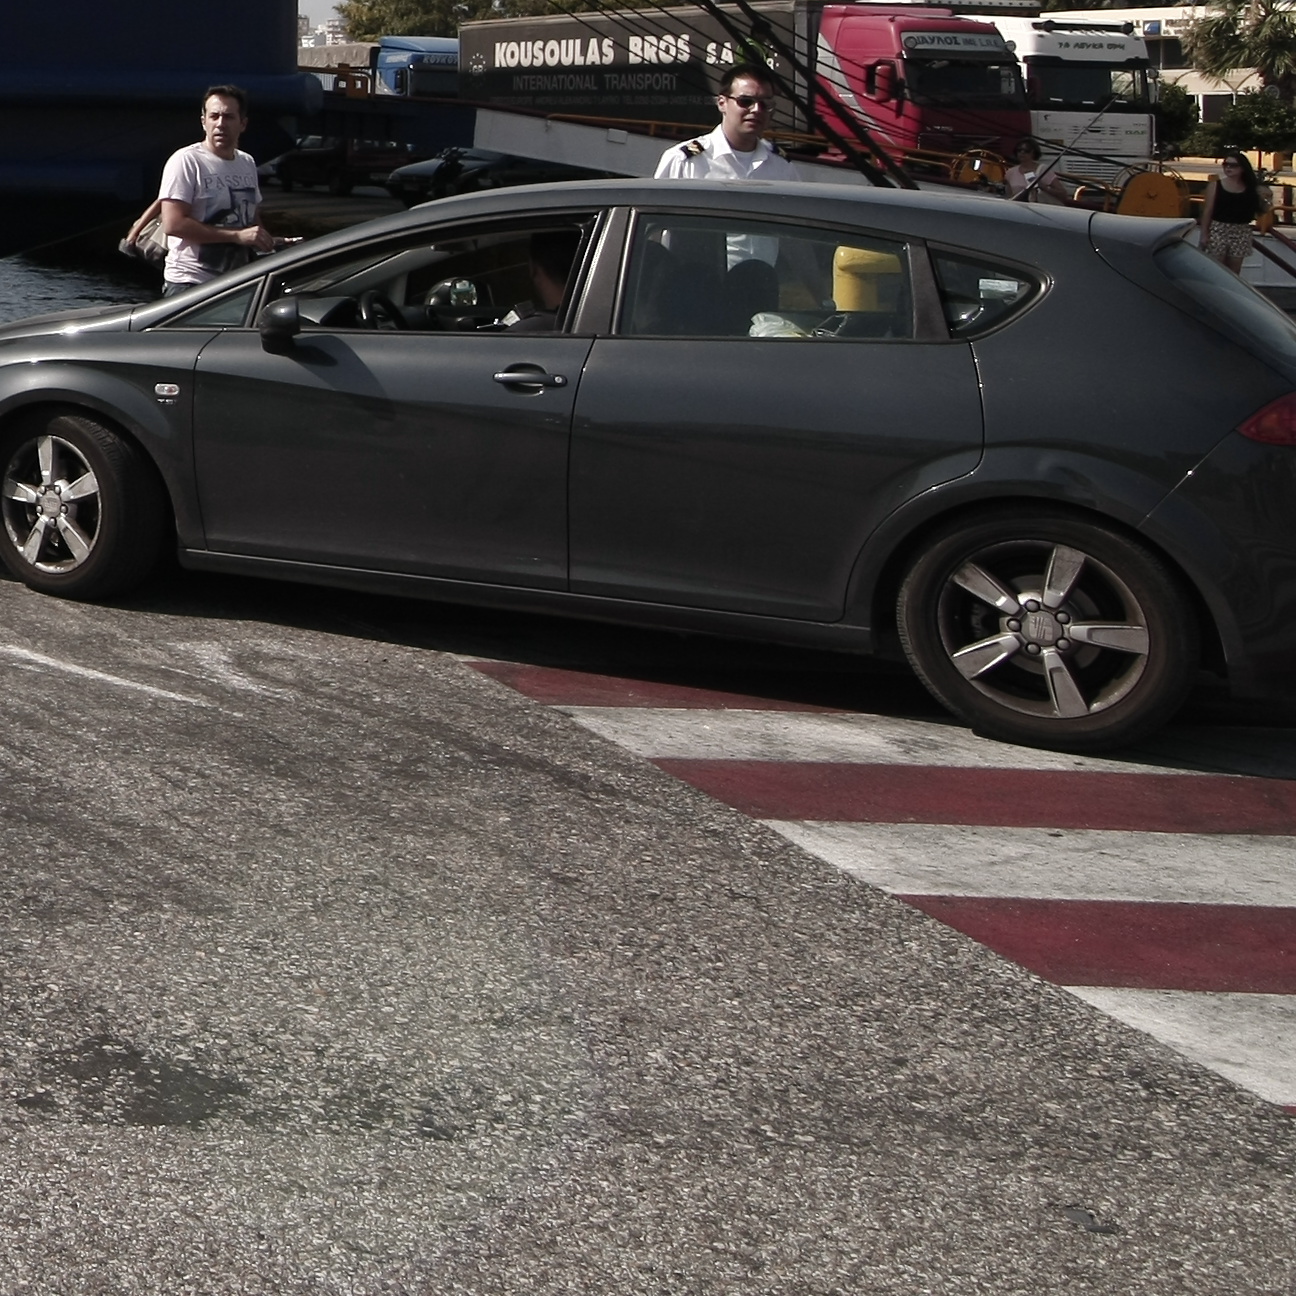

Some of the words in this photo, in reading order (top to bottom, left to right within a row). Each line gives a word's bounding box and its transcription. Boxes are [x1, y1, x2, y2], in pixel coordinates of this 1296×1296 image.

[495, 36, 614, 68] KOUSOULAS
[628, 34, 690, 65] BROS
[512, 74, 598, 91] INTERNATIONAL
[603, 73, 677, 91] TRANSPORT
